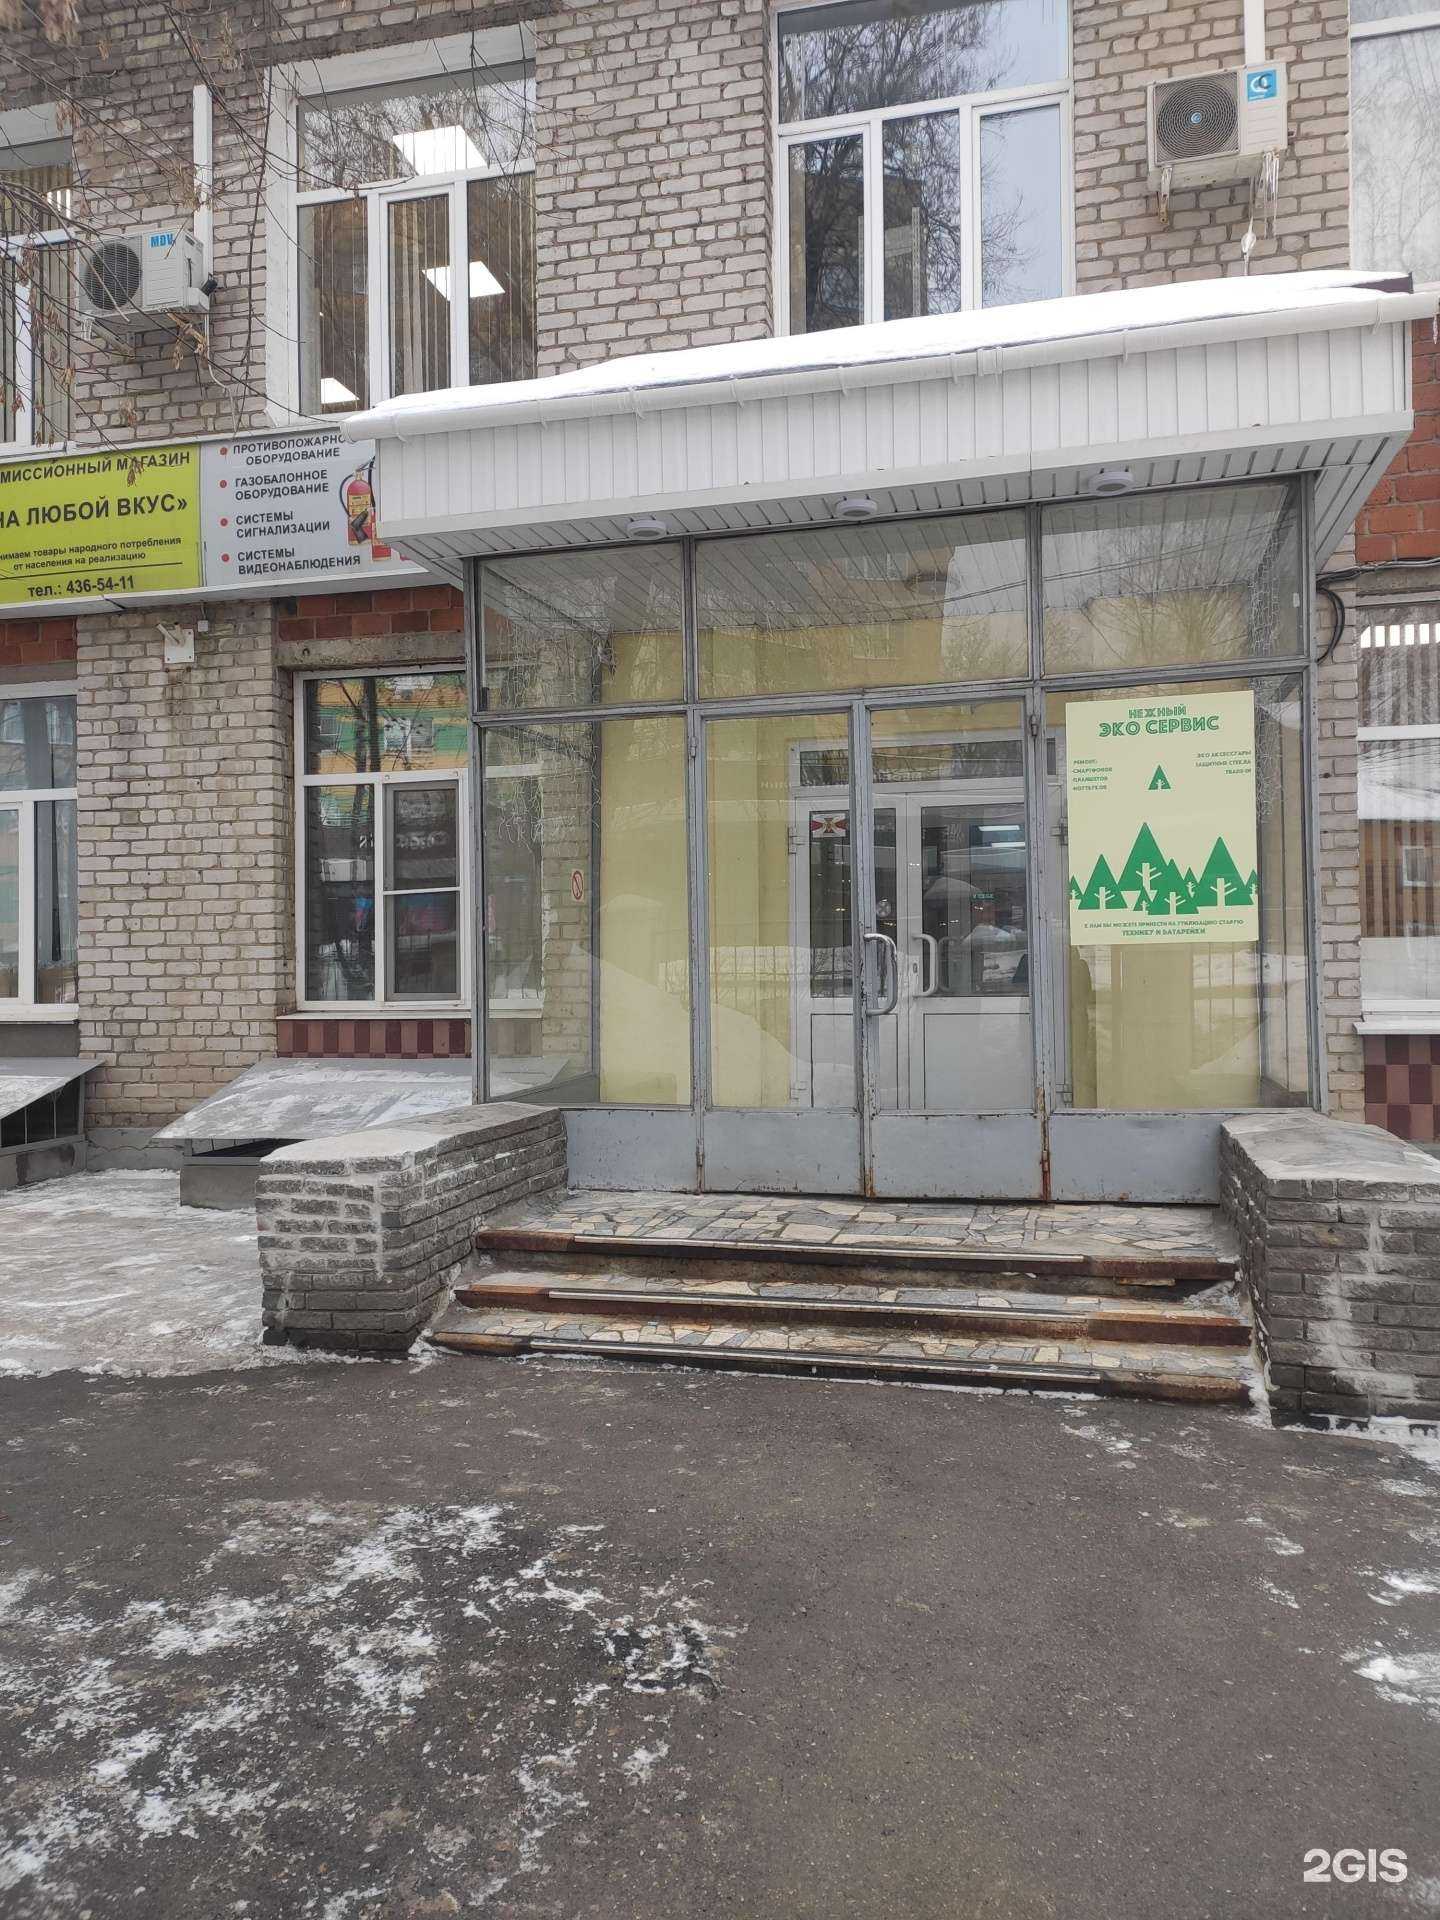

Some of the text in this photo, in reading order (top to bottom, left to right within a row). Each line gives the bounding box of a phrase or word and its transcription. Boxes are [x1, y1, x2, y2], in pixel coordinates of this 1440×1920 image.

[150, 233, 174, 248] MDV
[246, 447, 340, 466] ОБОРУДОВАНИЕ
[0, 451, 190, 484] МИССИОННЫЙ МАГАЗИН
[235, 469, 328, 488] ГАЗОБАЛОННОЕ
[235, 482, 329, 501] ОБОРУДОВАНИЕ
[26, 495, 109, 526] ЛЮБОЙ
[117, 493, 188, 517] ВКУС»
[236, 511, 294, 525] СИСТЕМЫ
[236, 521, 330, 539] СИГНАЛИЗАЦИИ
[33, 547, 67, 557] товары
[68, 542, 118, 556] народного
[120, 536, 182, 551] потребления
[237, 548, 295, 562] СИСТЕМЫ
[13, 563, 24, 571] от
[25, 557, 73, 570] населения
[88, 552, 146, 566] реализацию
[238, 555, 361, 575] ВИДЕОНАБЛЮДЕНИЯ
[27, 575, 135, 598] тел.: 436-54-11
[1128, 703, 1187, 719] НЕЖНЫЙ
[1098, 715, 1220, 738] ЭКО СЕРВИС
